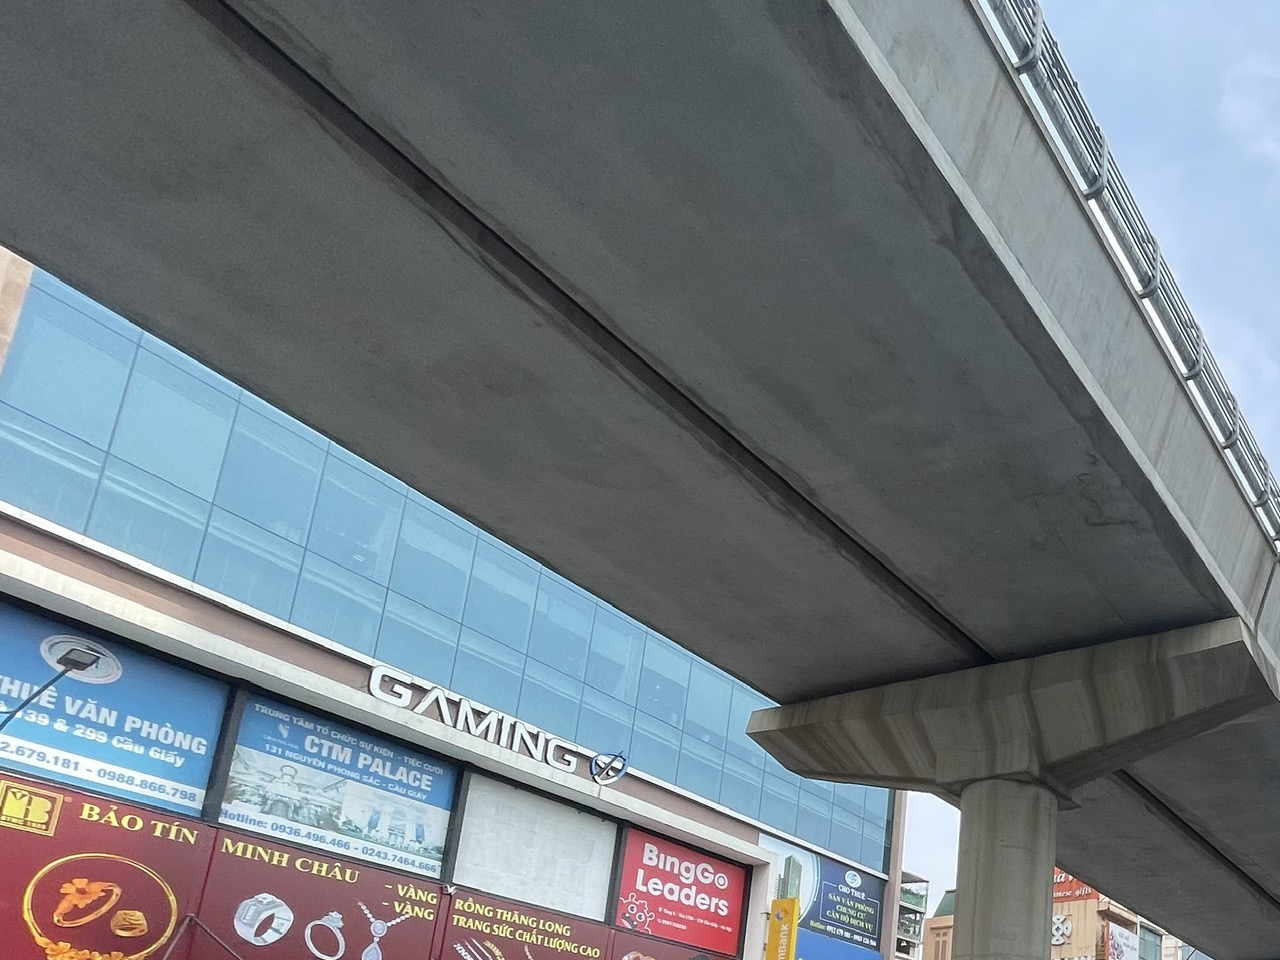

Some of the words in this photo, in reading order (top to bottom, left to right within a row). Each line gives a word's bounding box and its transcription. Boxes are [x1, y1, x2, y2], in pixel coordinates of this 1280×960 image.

[0, 675, 57, 709] HUÊ
[65, 696, 118, 727] VĂN
[124, 714, 208, 755] PHÒNG
[73, 723, 108, 743] 299
[254, 704, 290, 722] TRUNG
[292, 715, 314, 730] TÂM
[367, 665, 579, 773] GAMING
[97, 768, 197, 802] 0988.866.798
[304, 735, 353, 764] CTM
[357, 752, 433, 791] PALACE
[327, 763, 360, 781] PHONG
[79, 802, 144, 831] BẢO
[151, 820, 198, 845] TÍN
[221, 838, 290, 867] MINH
[295, 857, 360, 883] CHÂU
[220, 809, 267, 829] Hotline:
[271, 822, 351, 851] 0936.496.466
[361, 846, 437, 873] 0243.7464.666
[397, 882, 438, 905] VÀNG
[454, 897, 494, 917] RỒNG
[496, 908, 537, 928] THĂNG
[538, 919, 571, 937] LONG
[635, 868, 729, 916] Leaders
[394, 899, 434, 921] VÀNG
[452, 915, 491, 934] TRANG
[491, 923, 514, 939] SỨC
[515, 929, 543, 945] CHẤT
[544, 937, 578, 954] LƯỢNG
[579, 945, 600, 959] CAO
